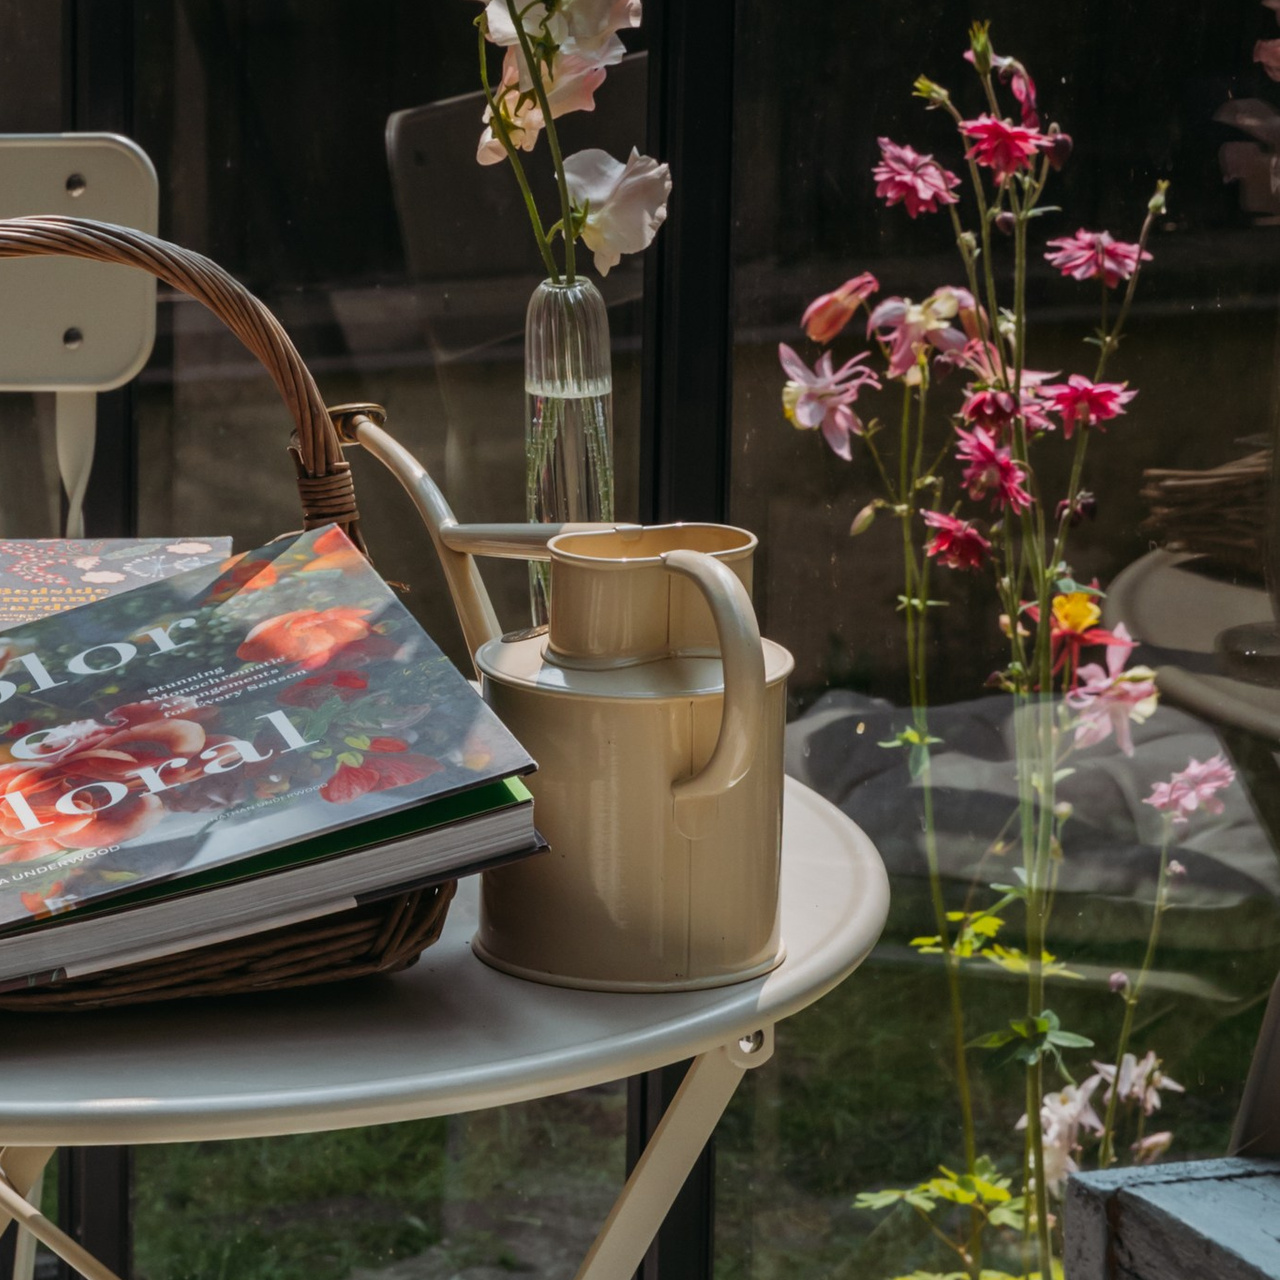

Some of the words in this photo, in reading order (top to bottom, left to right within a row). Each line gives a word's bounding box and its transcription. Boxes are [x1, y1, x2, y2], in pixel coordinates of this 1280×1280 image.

[146, 666, 226, 696] Stunning
[152, 656, 287, 703] Monochromatic
[159, 668, 280, 711] Arrangements
[163, 706, 191, 719] for
[193, 689, 244, 708] Every
[246, 669, 308, 693] Season
[209, 805, 254, 823] NATHAN
[255, 782, 329, 809] UNDERWOOD
[14, 844, 121, 882] UNDERWOOD
